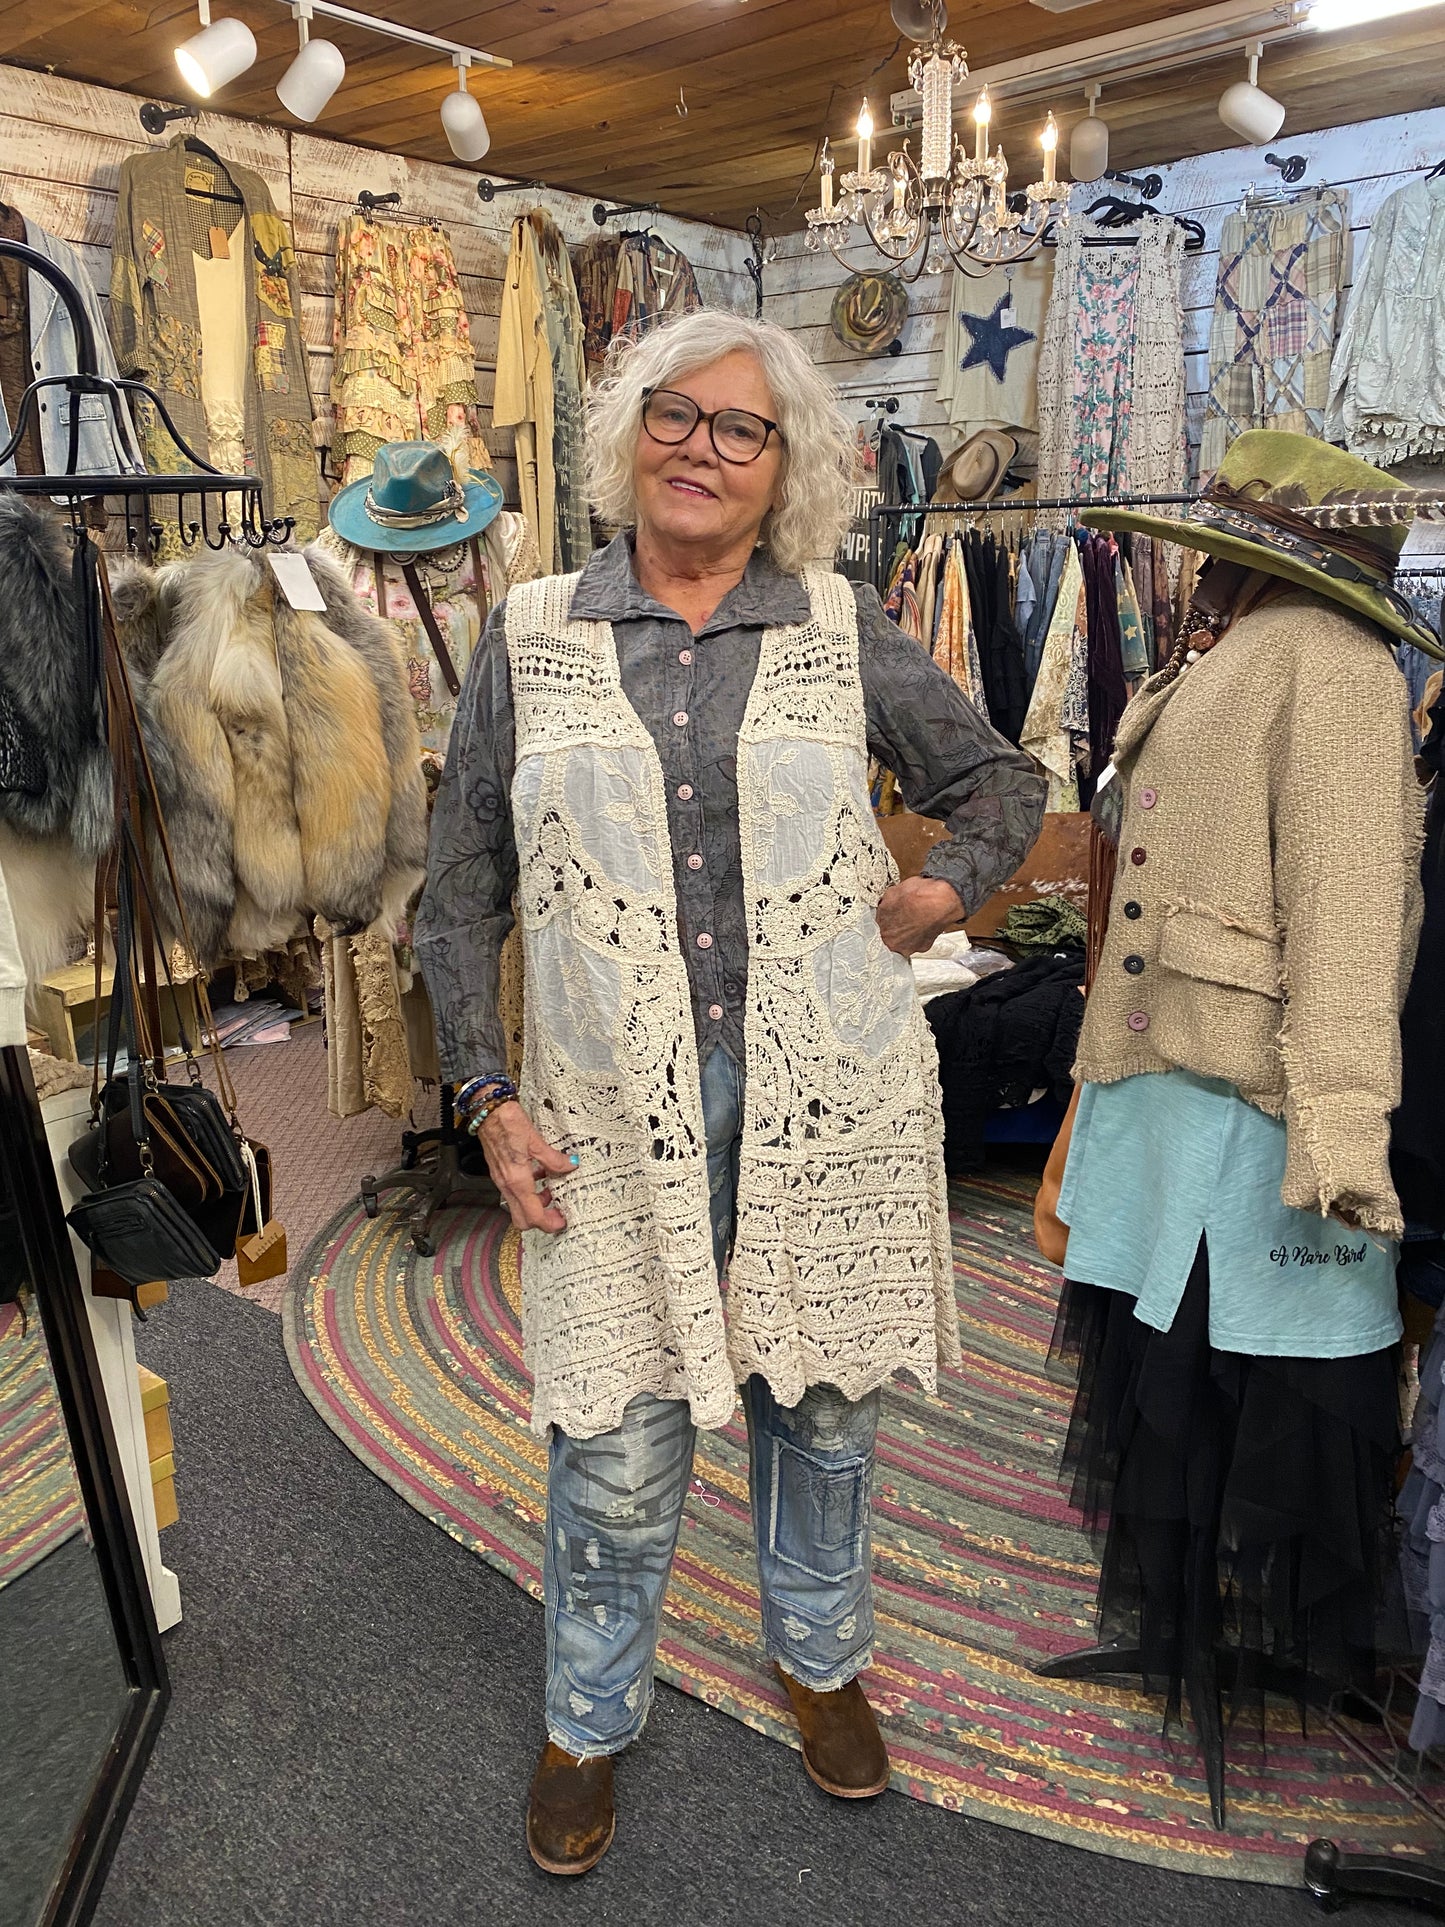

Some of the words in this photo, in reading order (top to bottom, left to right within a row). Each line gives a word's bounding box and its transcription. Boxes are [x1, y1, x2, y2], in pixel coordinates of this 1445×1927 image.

[1270, 1245, 1289, 1267] A
[1292, 1246, 1331, 1266] Rare
[1334, 1243, 1367, 1266] Bird
